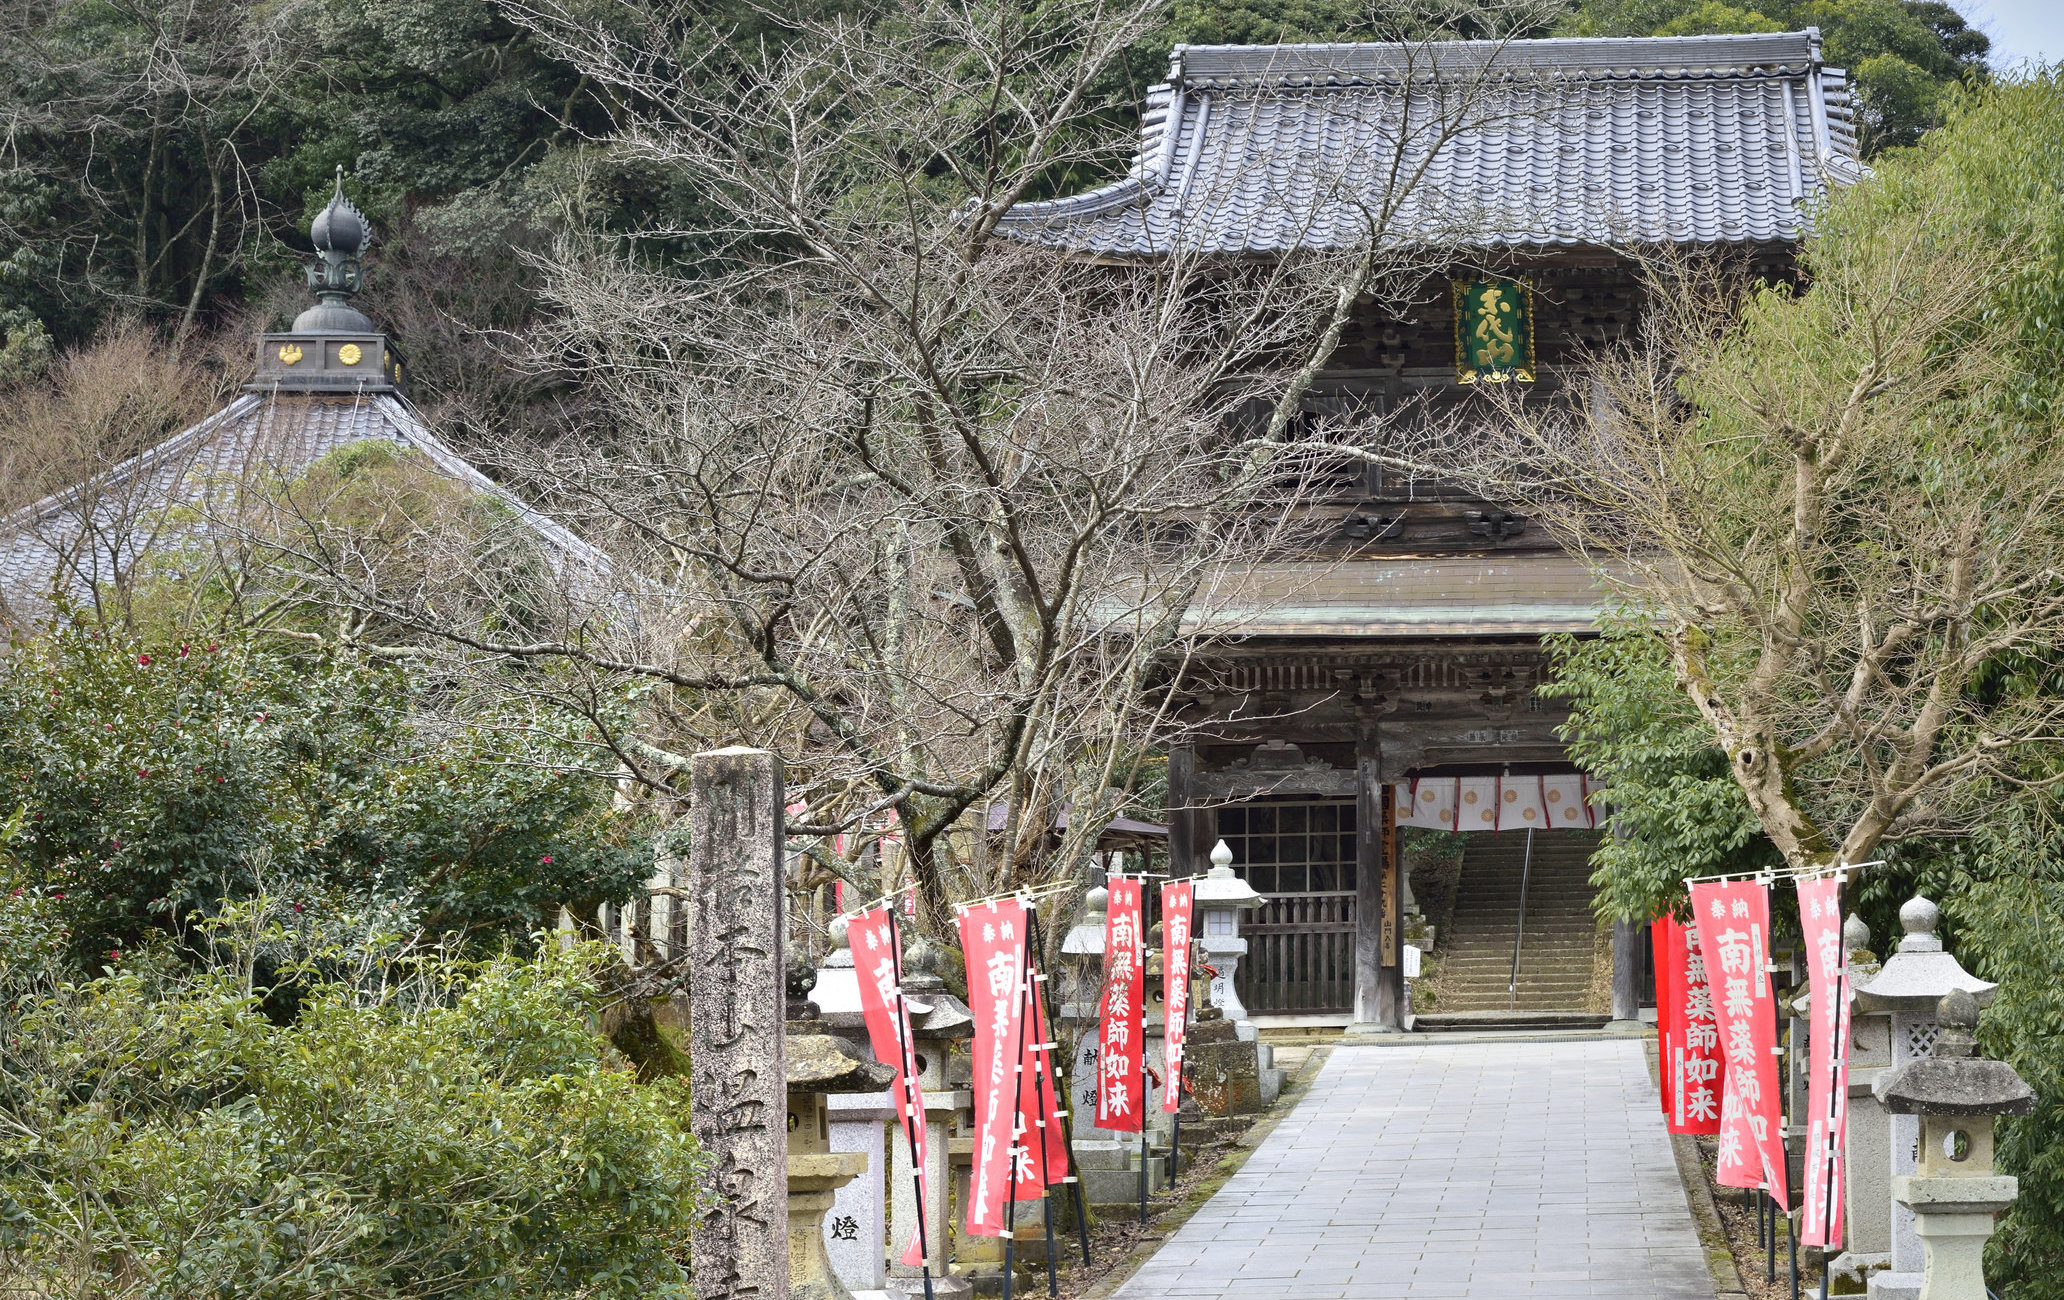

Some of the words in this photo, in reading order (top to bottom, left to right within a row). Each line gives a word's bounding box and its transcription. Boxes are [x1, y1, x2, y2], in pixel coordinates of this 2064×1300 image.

[1113, 889, 1133, 907] 奉納
[1169, 893, 1188, 909] 奉納
[1711, 898, 1750, 919] 奉納
[982, 920, 1015, 943] 奉納
[1106, 912, 1134, 1117] 南無薬師如来
[831, 1215, 860, 1241] 燈
